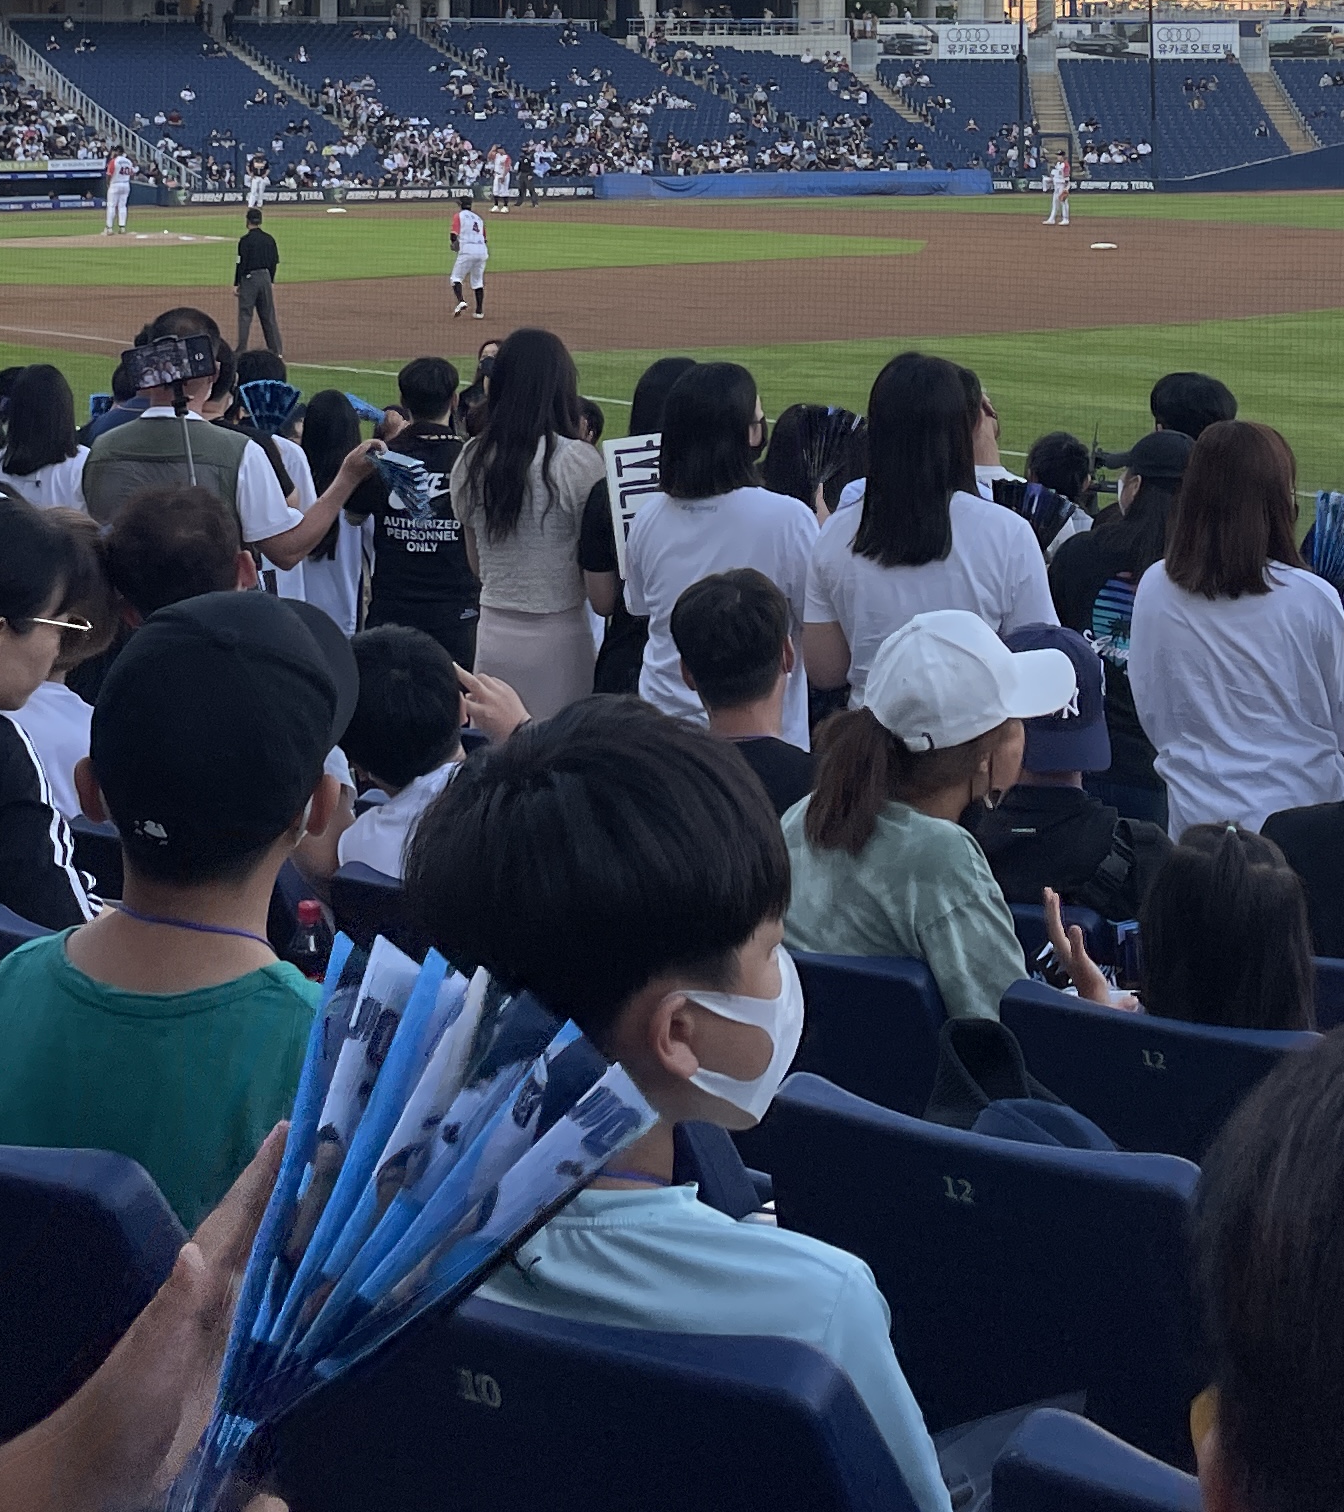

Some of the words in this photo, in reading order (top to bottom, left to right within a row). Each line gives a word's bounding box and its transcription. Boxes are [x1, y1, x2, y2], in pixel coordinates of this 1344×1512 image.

[1158, 43, 1232, 55] 유카로오토모빌
[387, 527, 459, 541] PERSONNEL
[406, 541, 438, 553] ONLY
[1142, 1049, 1166, 1069] 12
[942, 1176, 975, 1204] 12
[459, 1368, 503, 1407] 10
